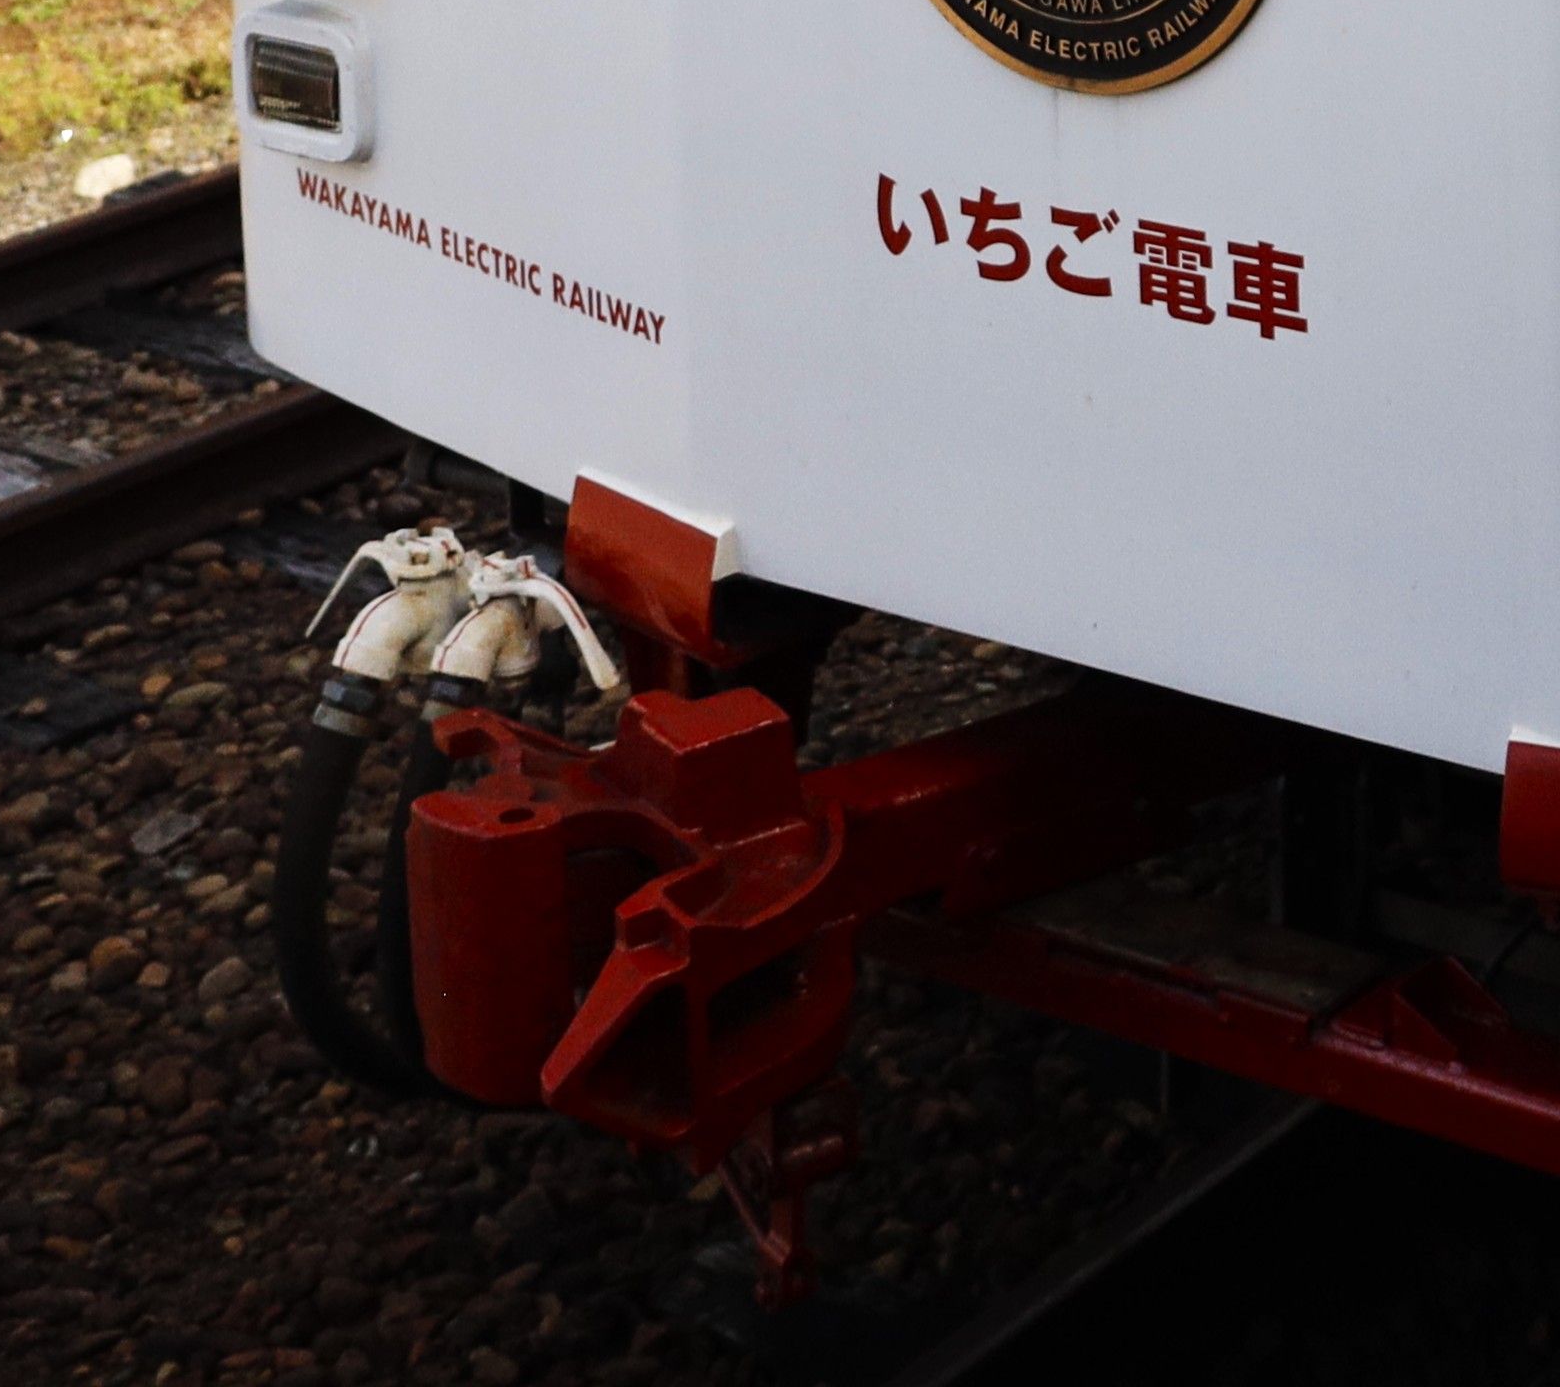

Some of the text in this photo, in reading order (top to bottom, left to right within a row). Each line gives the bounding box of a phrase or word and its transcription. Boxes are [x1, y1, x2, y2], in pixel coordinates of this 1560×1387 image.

[1029, 30, 1141, 63] ELECTRIC
[297, 167, 666, 346] WAKAYAMA ELECTRIC RAILWAY
[876, 172, 1309, 341] いちご電車
